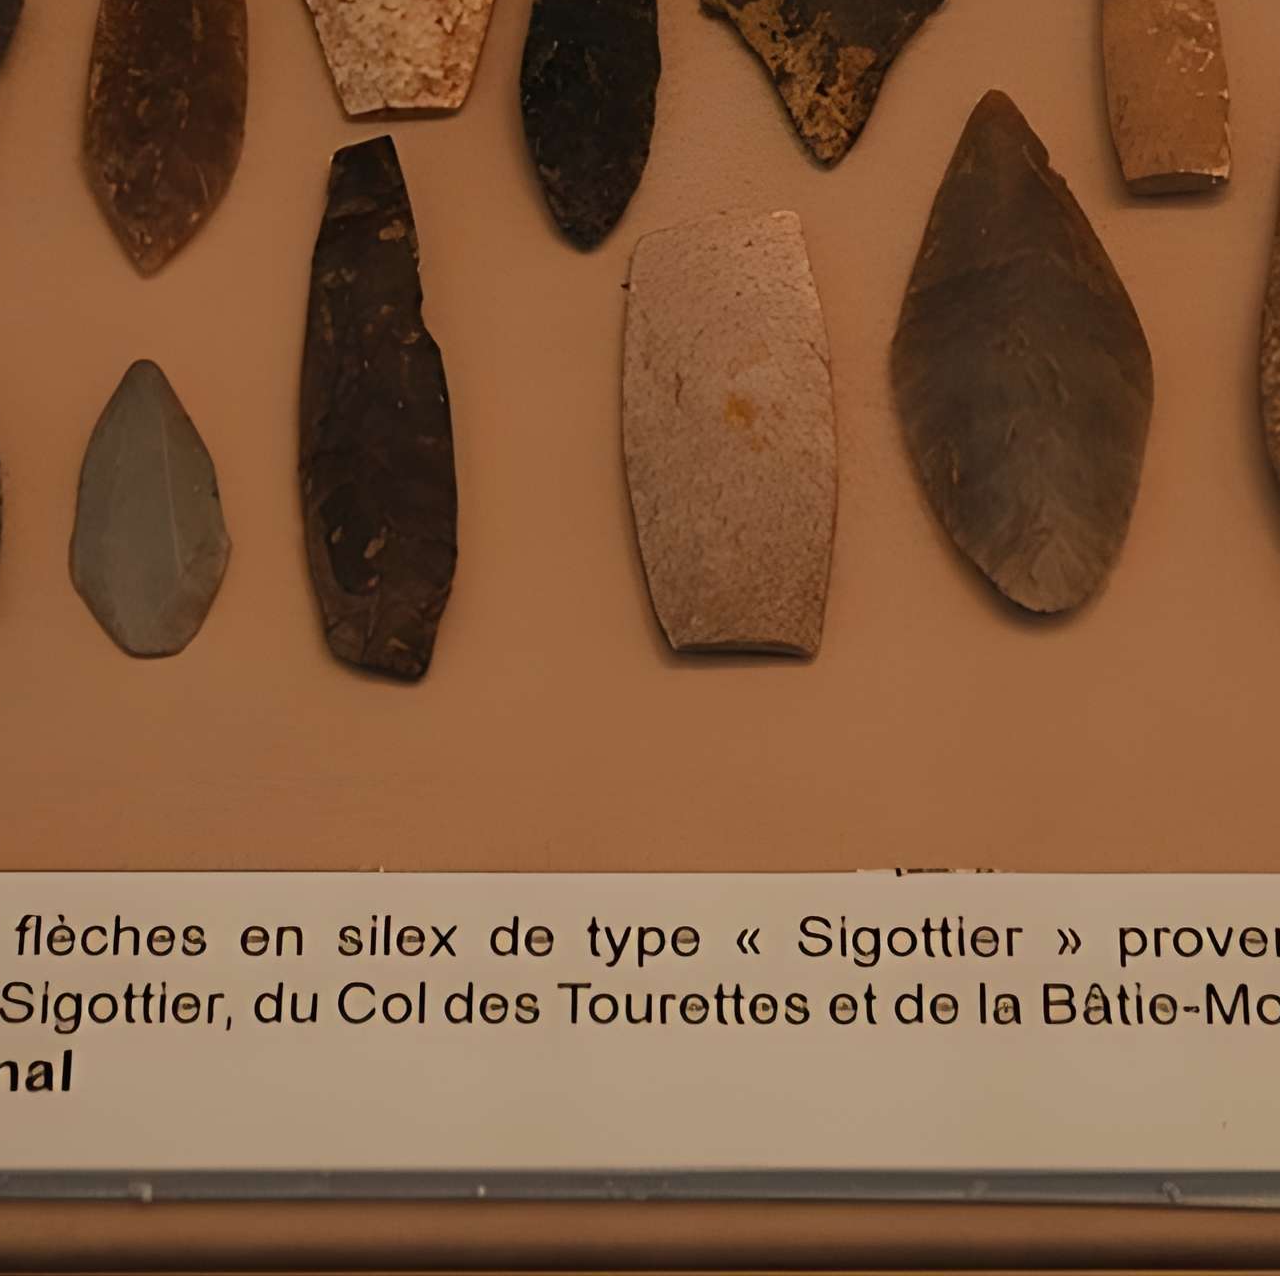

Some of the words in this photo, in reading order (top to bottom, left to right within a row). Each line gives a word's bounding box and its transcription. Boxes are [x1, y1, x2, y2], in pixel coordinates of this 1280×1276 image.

[14, 913, 207, 957] flèches
[240, 925, 303, 957] en
[337, 914, 458, 958] silex
[489, 915, 555, 957] de
[586, 916, 701, 968] type
[797, 915, 1024, 968] Sigottier
[254, 981, 318, 1024] du
[337, 981, 426, 1025] Col
[444, 981, 540, 1025] des
[557, 982, 810, 1026] Tourettes
[828, 982, 877, 1025] et
[894, 983, 959, 1025] de
[979, 982, 1022, 1026] la
